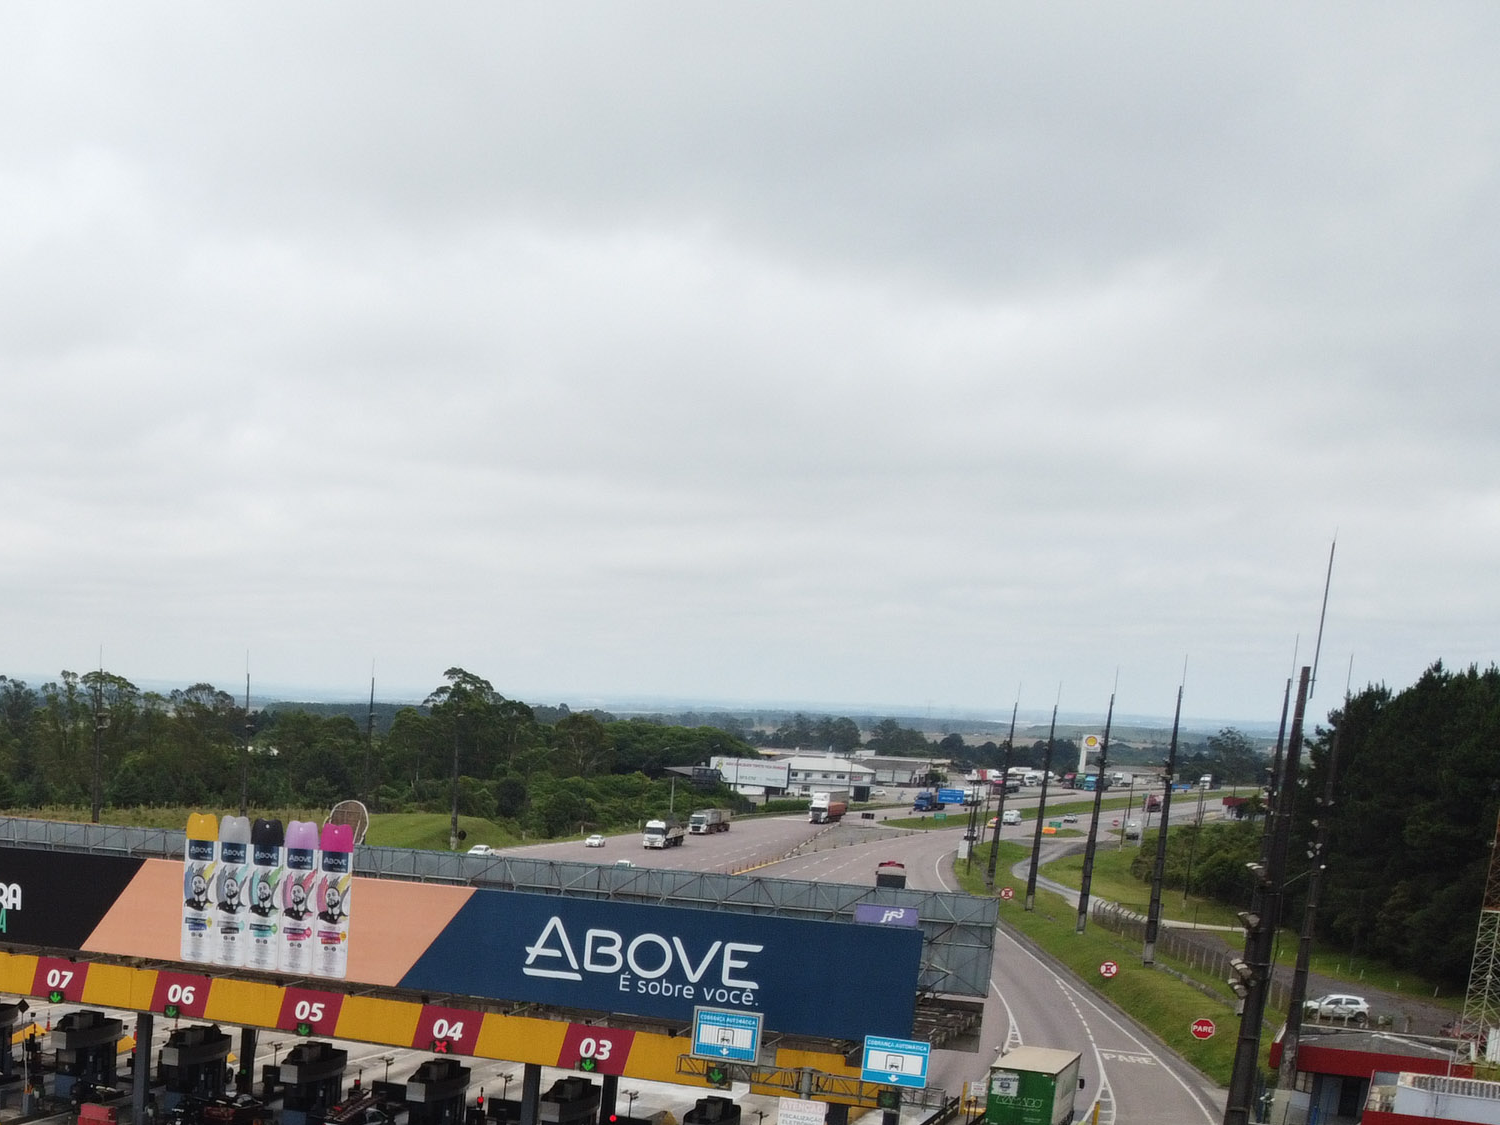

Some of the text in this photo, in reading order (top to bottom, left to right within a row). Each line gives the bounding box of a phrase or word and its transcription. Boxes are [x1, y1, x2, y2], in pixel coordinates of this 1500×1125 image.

[522, 916, 764, 990] ABOVE
[46, 969, 74, 989] 07
[619, 972, 759, 1007] É sobre você.
[167, 984, 196, 1004] 06
[295, 1000, 326, 1022] 05
[432, 1019, 464, 1041] 04
[1192, 1025, 1213, 1034] PARE
[579, 1038, 613, 1060] 03
[1102, 1052, 1157, 1066] PARE
